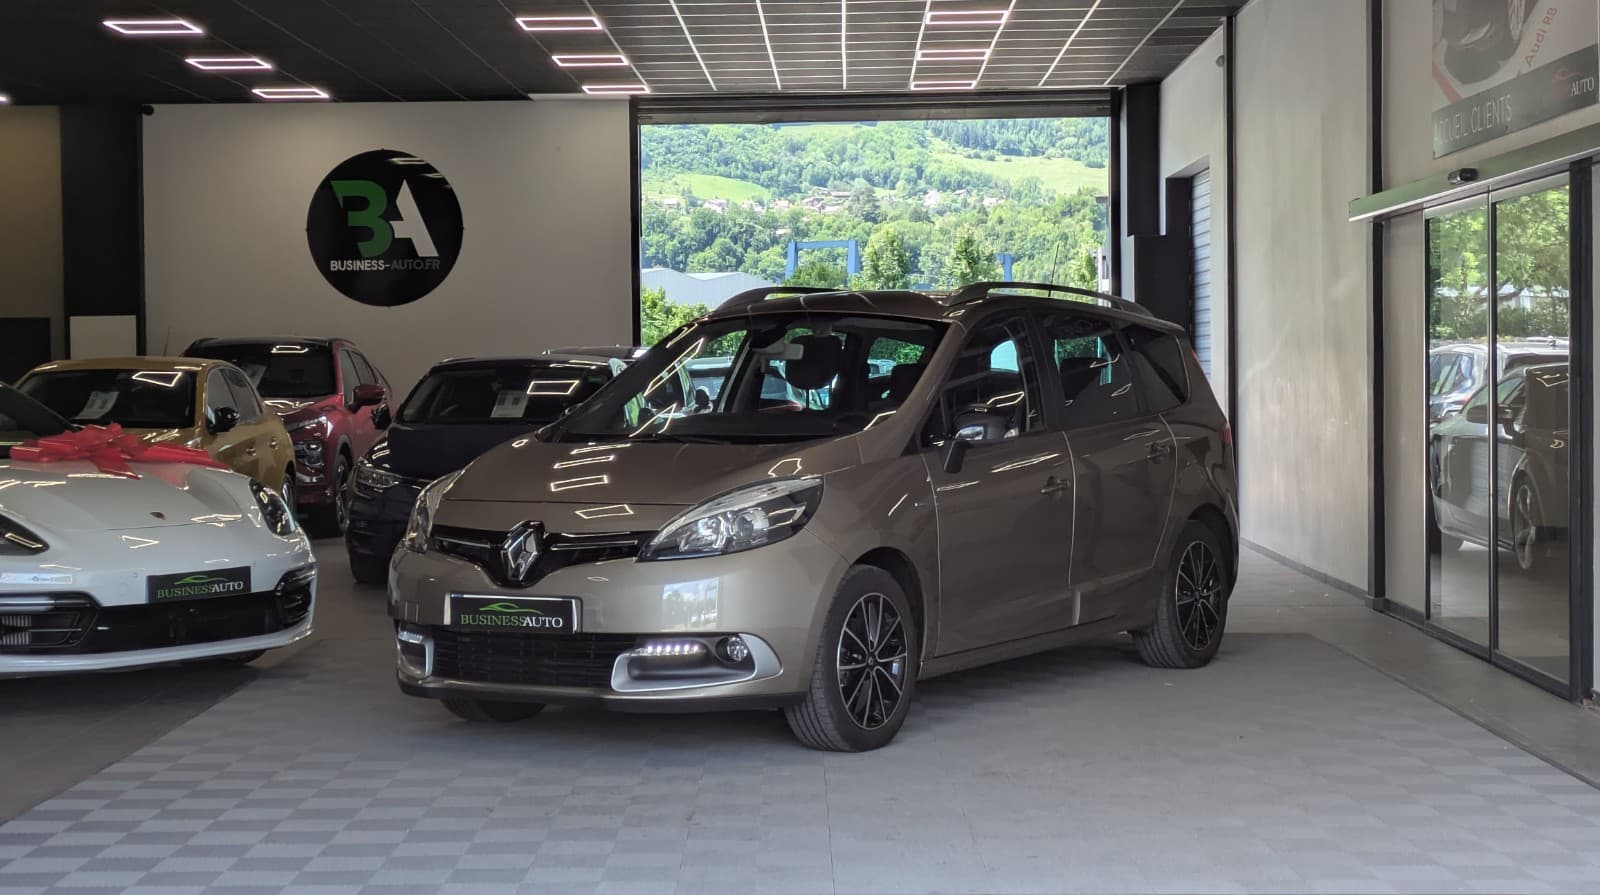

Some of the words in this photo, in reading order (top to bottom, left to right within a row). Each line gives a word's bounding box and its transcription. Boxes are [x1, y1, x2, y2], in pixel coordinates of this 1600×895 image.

[1524, 28, 1548, 67] Audi
[1471, 94, 1512, 133] CLIENTS
[330, 259, 440, 271] BUSINESS-AUTO.FR
